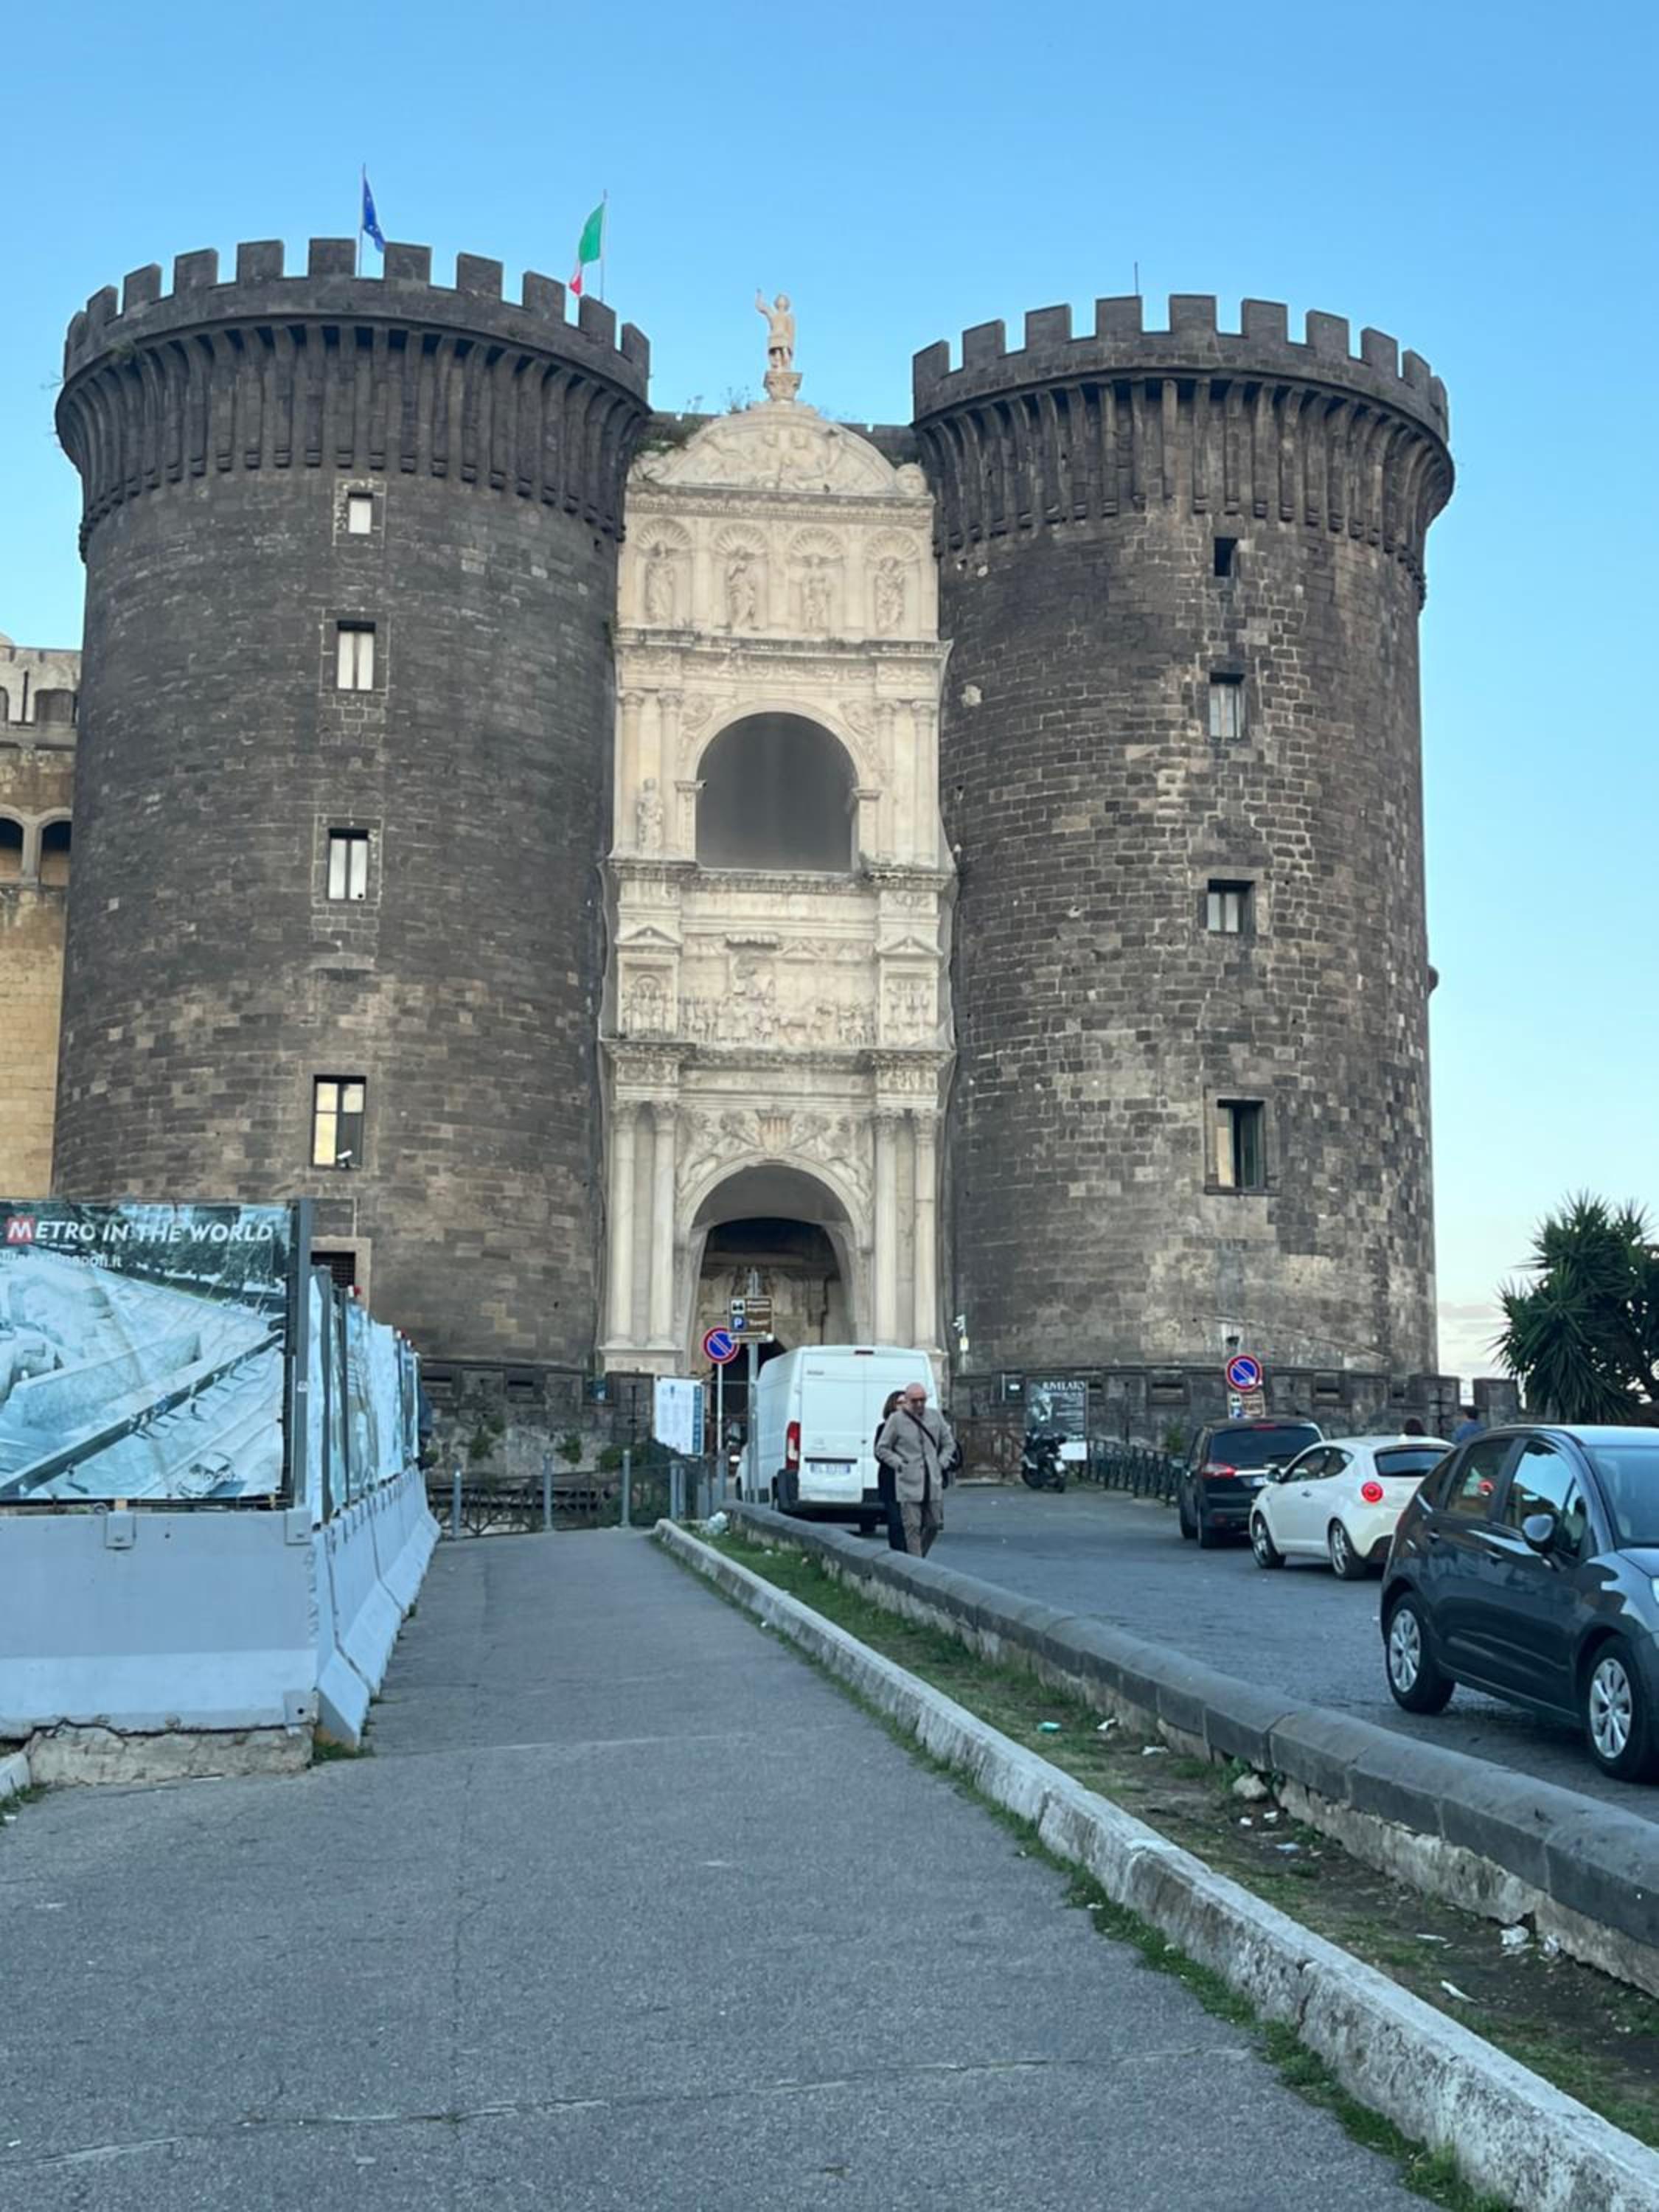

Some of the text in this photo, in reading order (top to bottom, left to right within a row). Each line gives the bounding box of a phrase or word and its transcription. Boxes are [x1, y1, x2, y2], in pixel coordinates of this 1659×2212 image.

[7, 1220, 274, 1242] METRO IN THE WORLD
